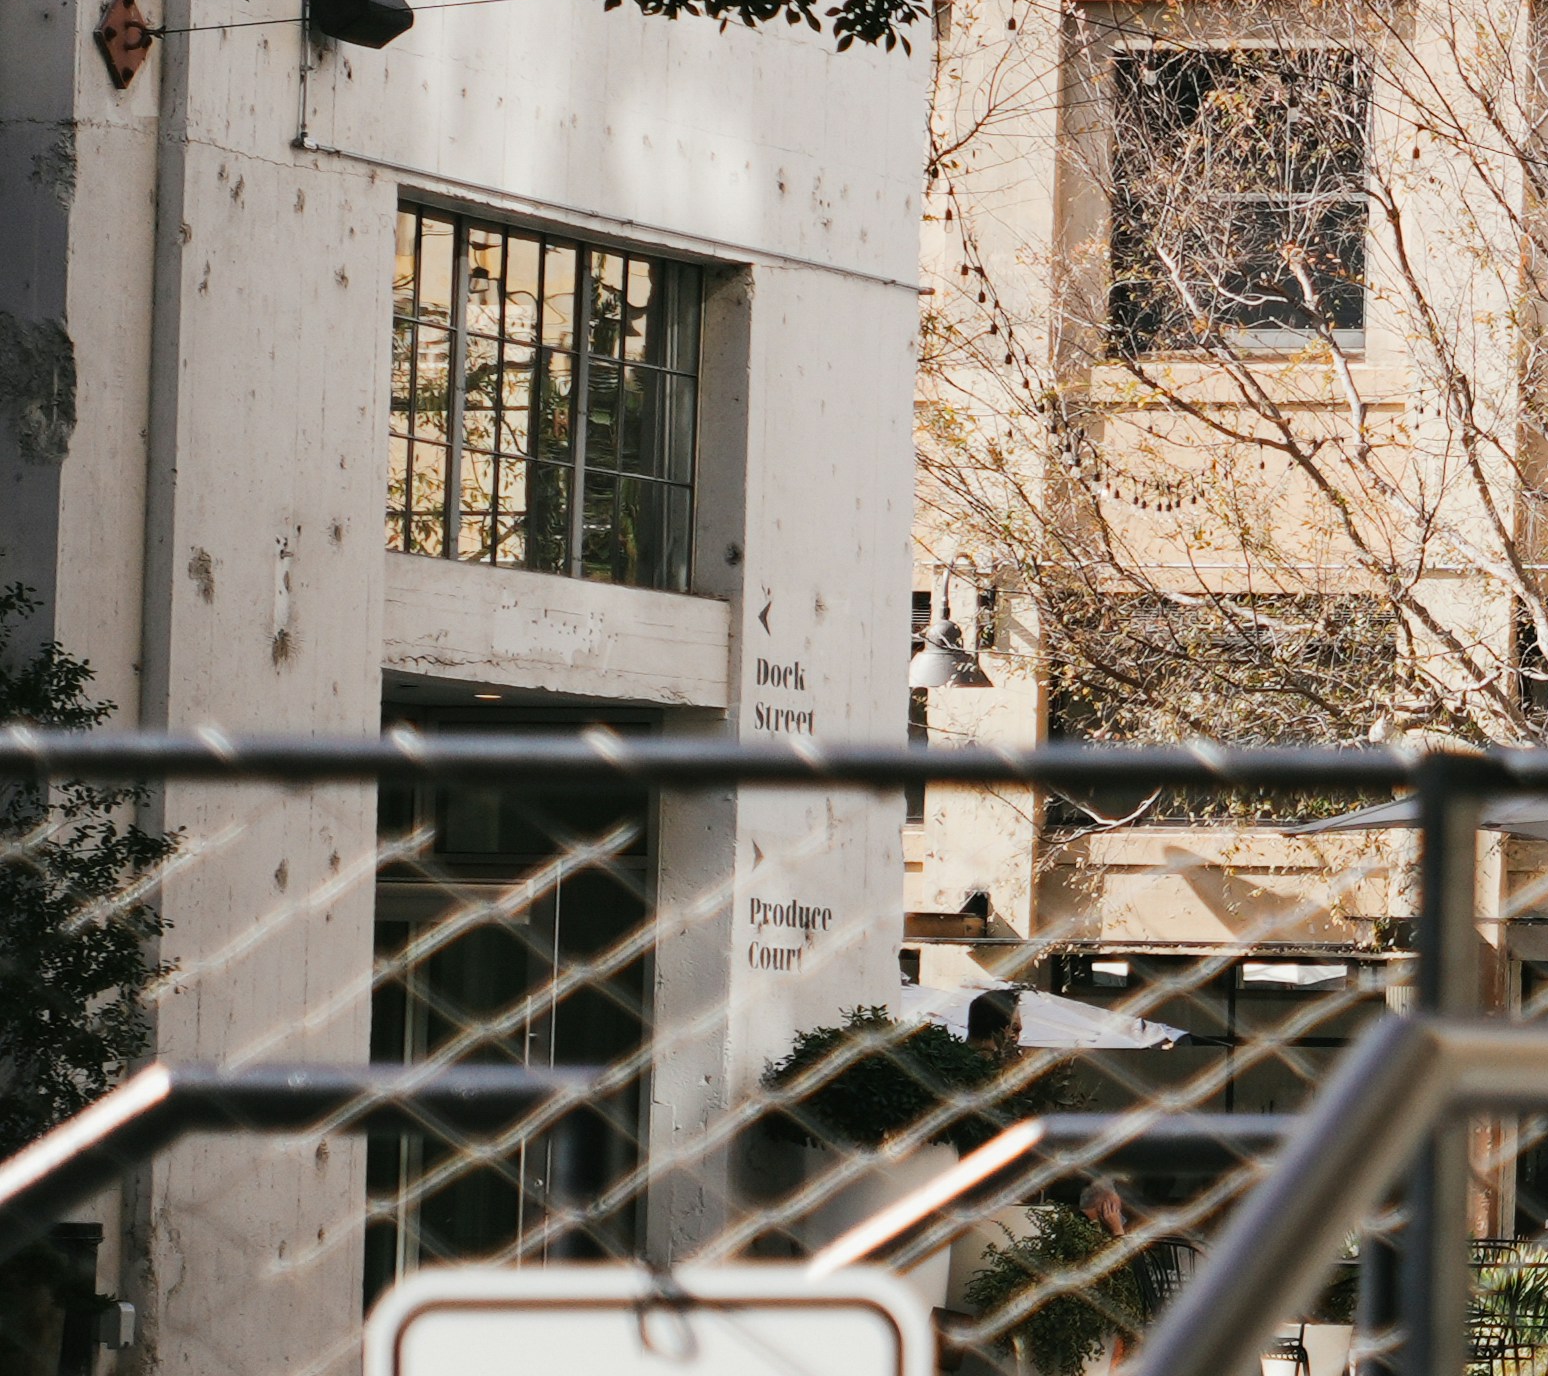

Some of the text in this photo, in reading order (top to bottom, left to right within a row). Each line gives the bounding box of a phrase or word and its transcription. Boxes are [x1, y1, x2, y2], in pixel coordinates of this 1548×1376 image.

[755, 657, 805, 691] Dock
[753, 701, 817, 736] Street
[749, 896, 833, 931] Produce
[748, 940, 804, 972] Court
